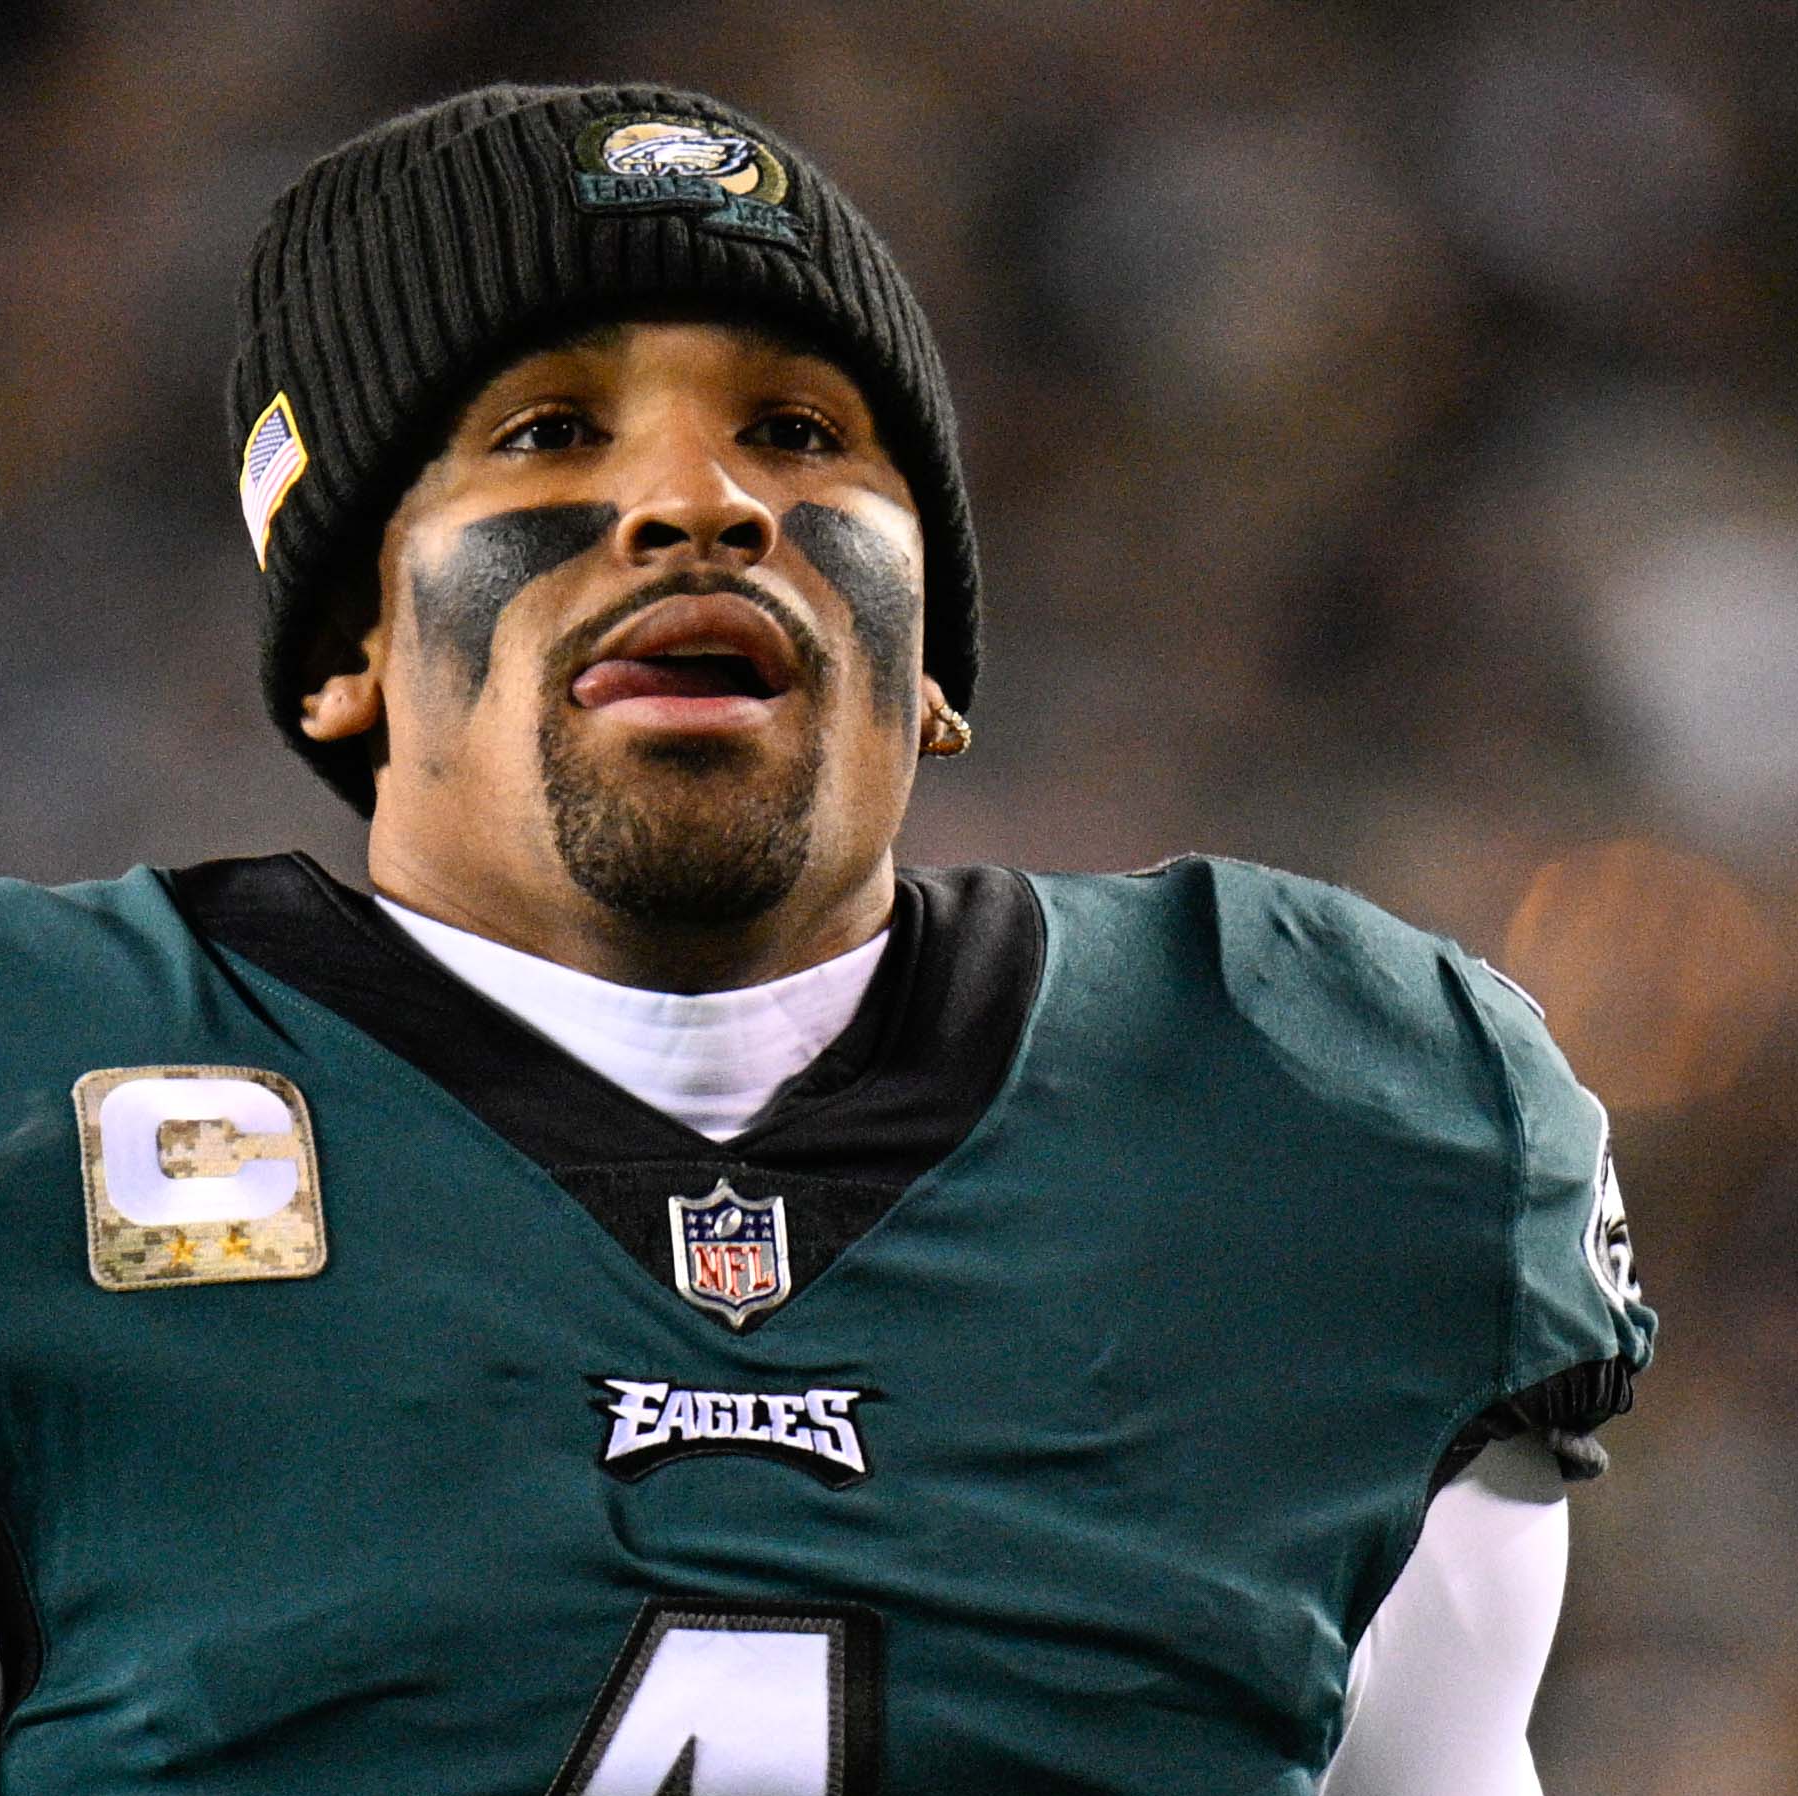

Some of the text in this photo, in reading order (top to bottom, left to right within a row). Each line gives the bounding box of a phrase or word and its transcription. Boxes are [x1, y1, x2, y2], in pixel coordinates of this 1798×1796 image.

[99, 1078, 299, 1226] C
[692, 1245, 775, 1297] NFL
[604, 1377, 866, 1474] EAGLES
